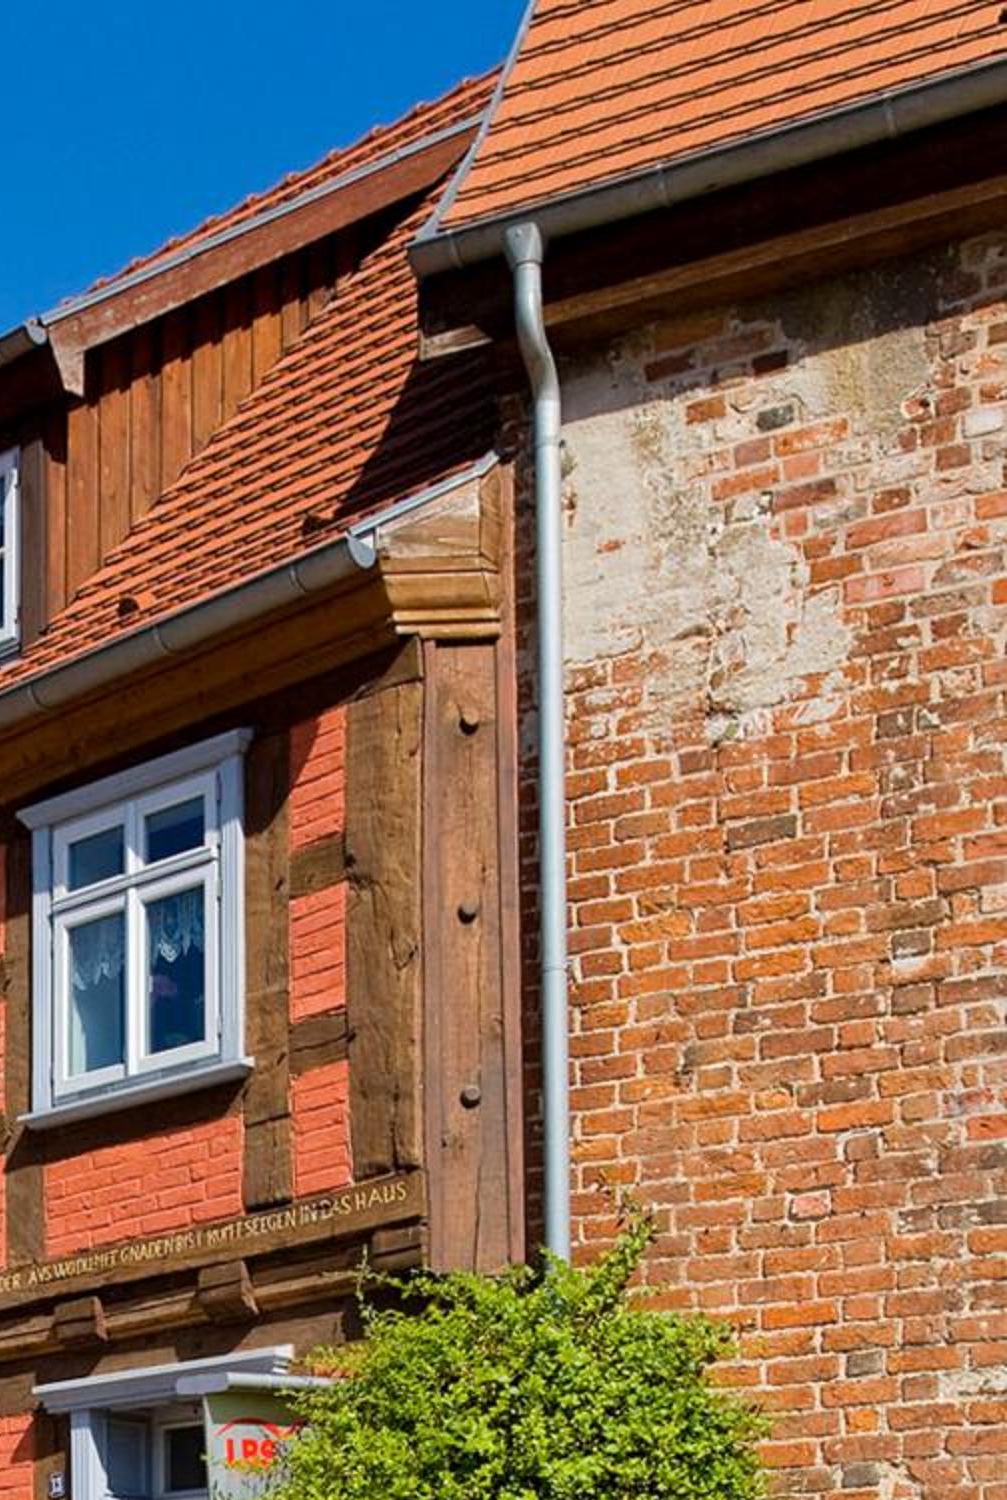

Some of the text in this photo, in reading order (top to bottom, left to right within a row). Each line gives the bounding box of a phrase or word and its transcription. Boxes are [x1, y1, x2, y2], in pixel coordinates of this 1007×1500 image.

[120, 1237, 173, 1263] GNADEN
[243, 1208, 297, 1236] SEEGEN
[299, 1201, 318, 1225] IN
[319, 1195, 352, 1219] DAS
[355, 1181, 407, 1211] HAUS
